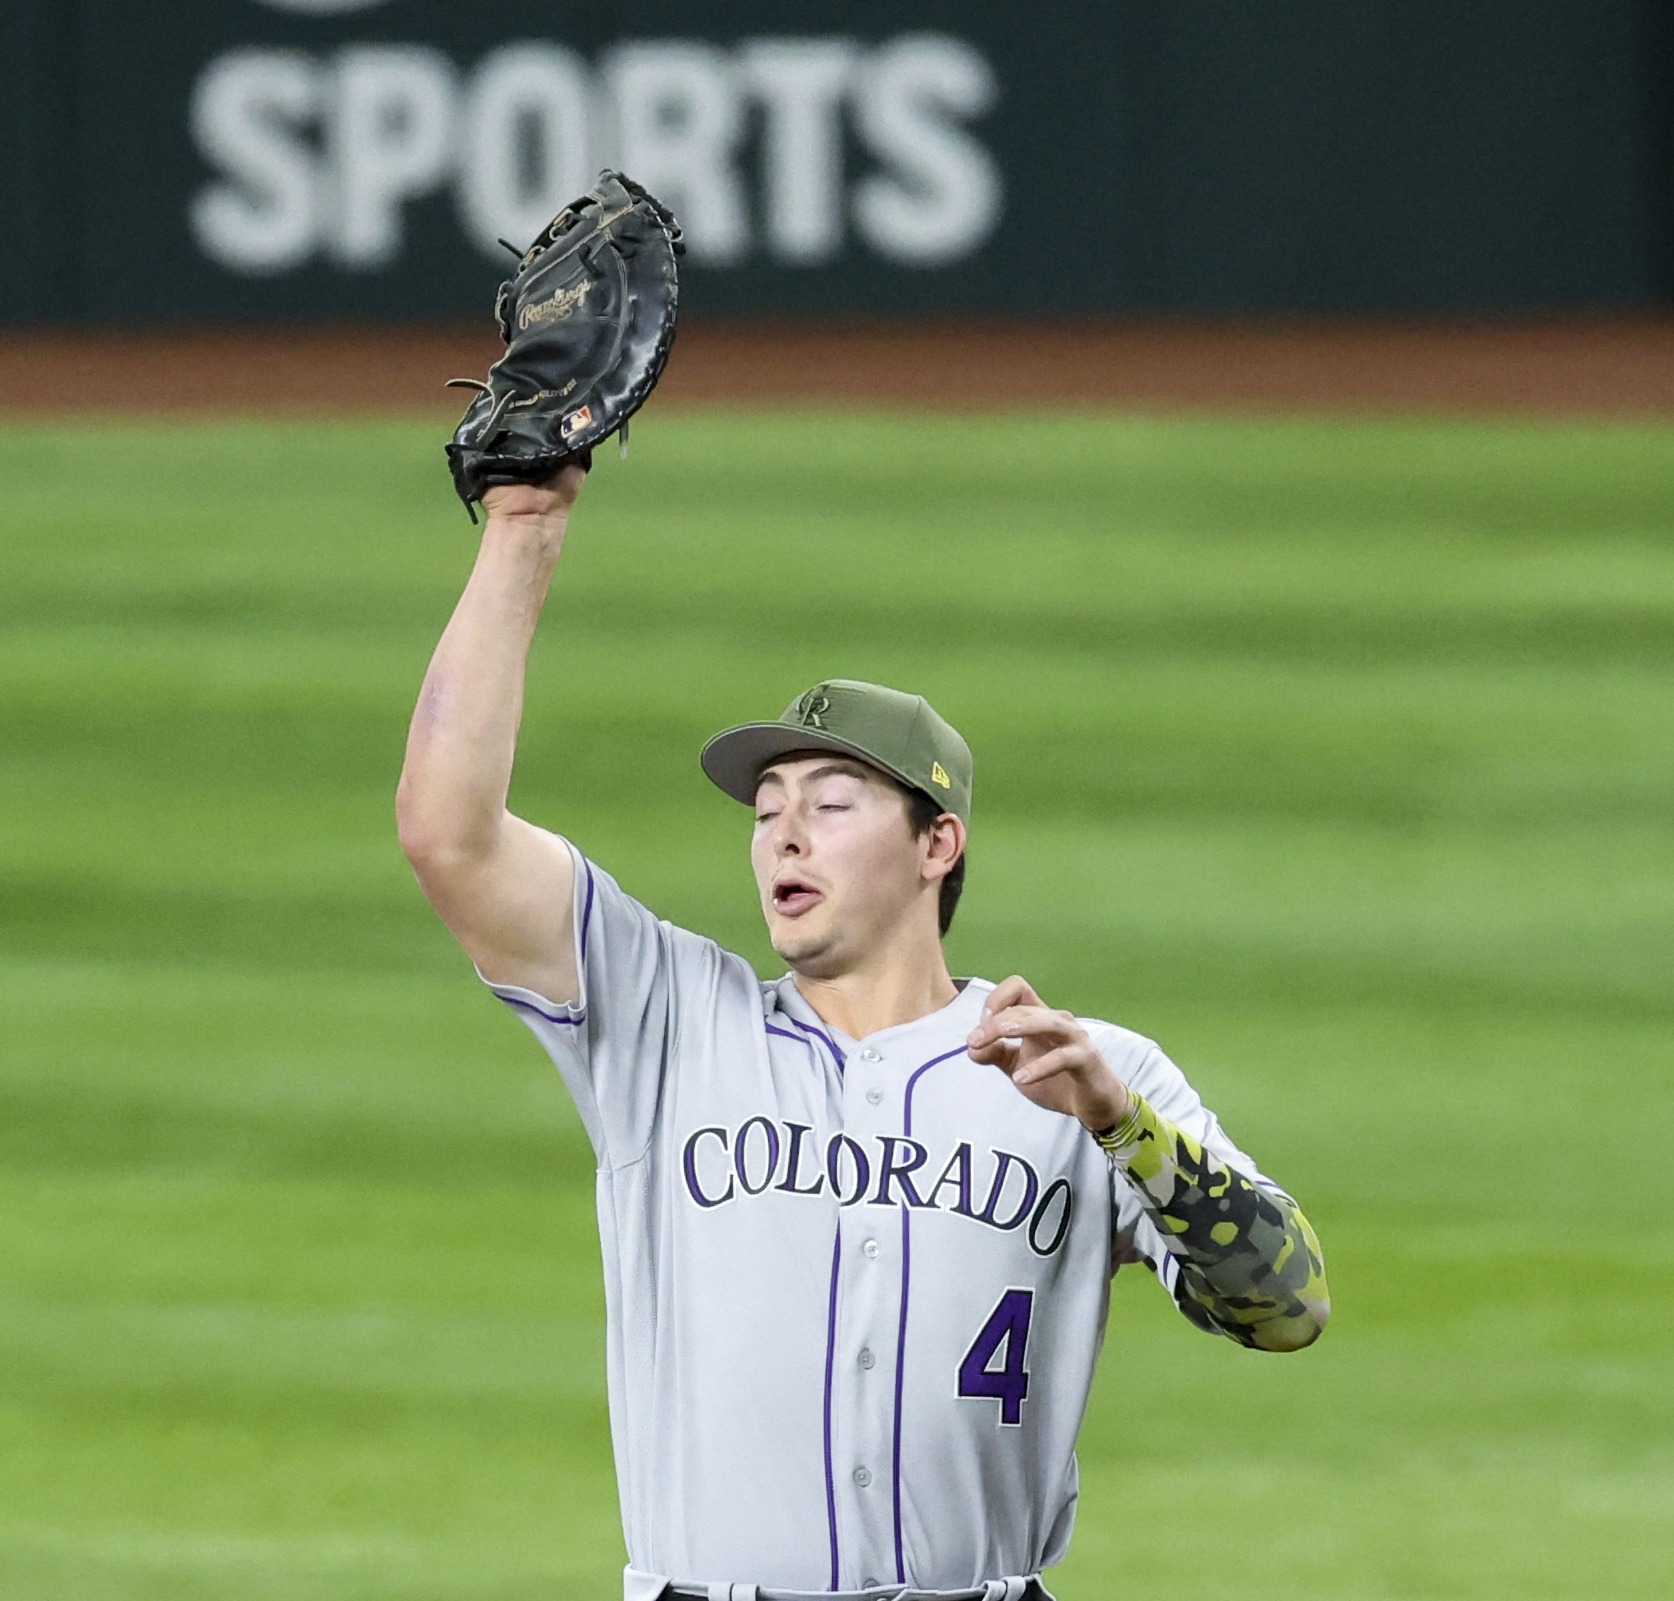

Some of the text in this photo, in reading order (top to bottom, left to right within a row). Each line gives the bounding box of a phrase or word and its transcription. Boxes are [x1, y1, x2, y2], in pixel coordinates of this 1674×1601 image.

[188, 34, 1002, 274] SPORTS
[682, 1115, 1074, 1258] COLORADO
[954, 1285, 1035, 1428] 4
